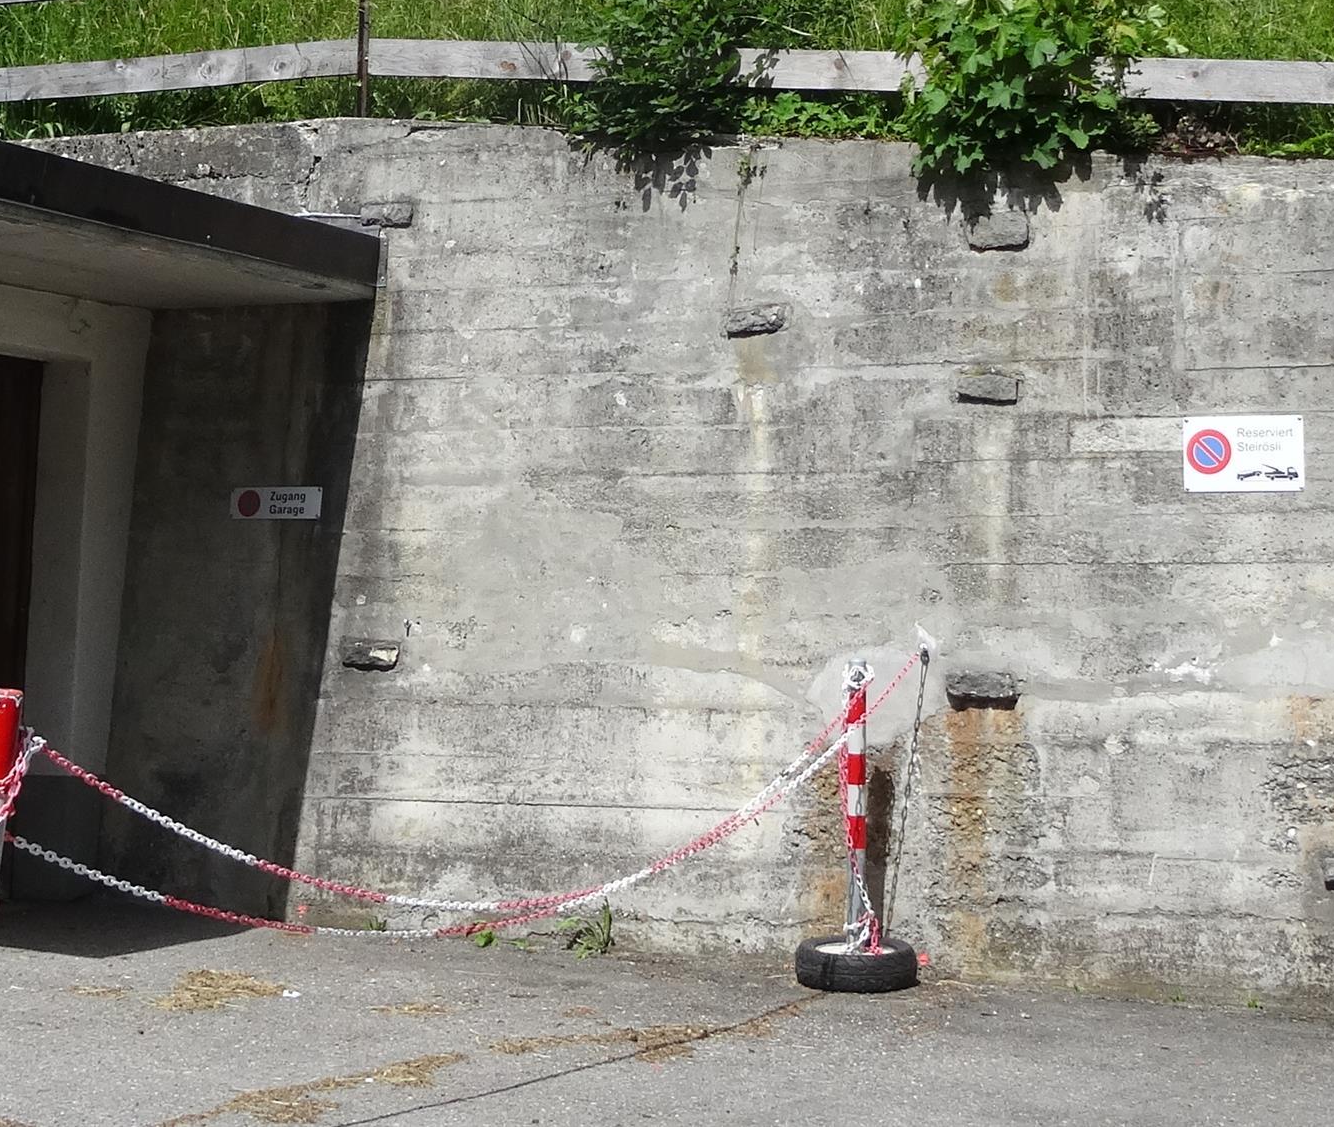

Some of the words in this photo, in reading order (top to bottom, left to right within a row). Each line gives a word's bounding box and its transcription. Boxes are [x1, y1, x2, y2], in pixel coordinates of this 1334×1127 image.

[1236, 427, 1294, 438] Reserviert
[269, 491, 306, 503] Zugang
[269, 505, 305, 516] Garage
